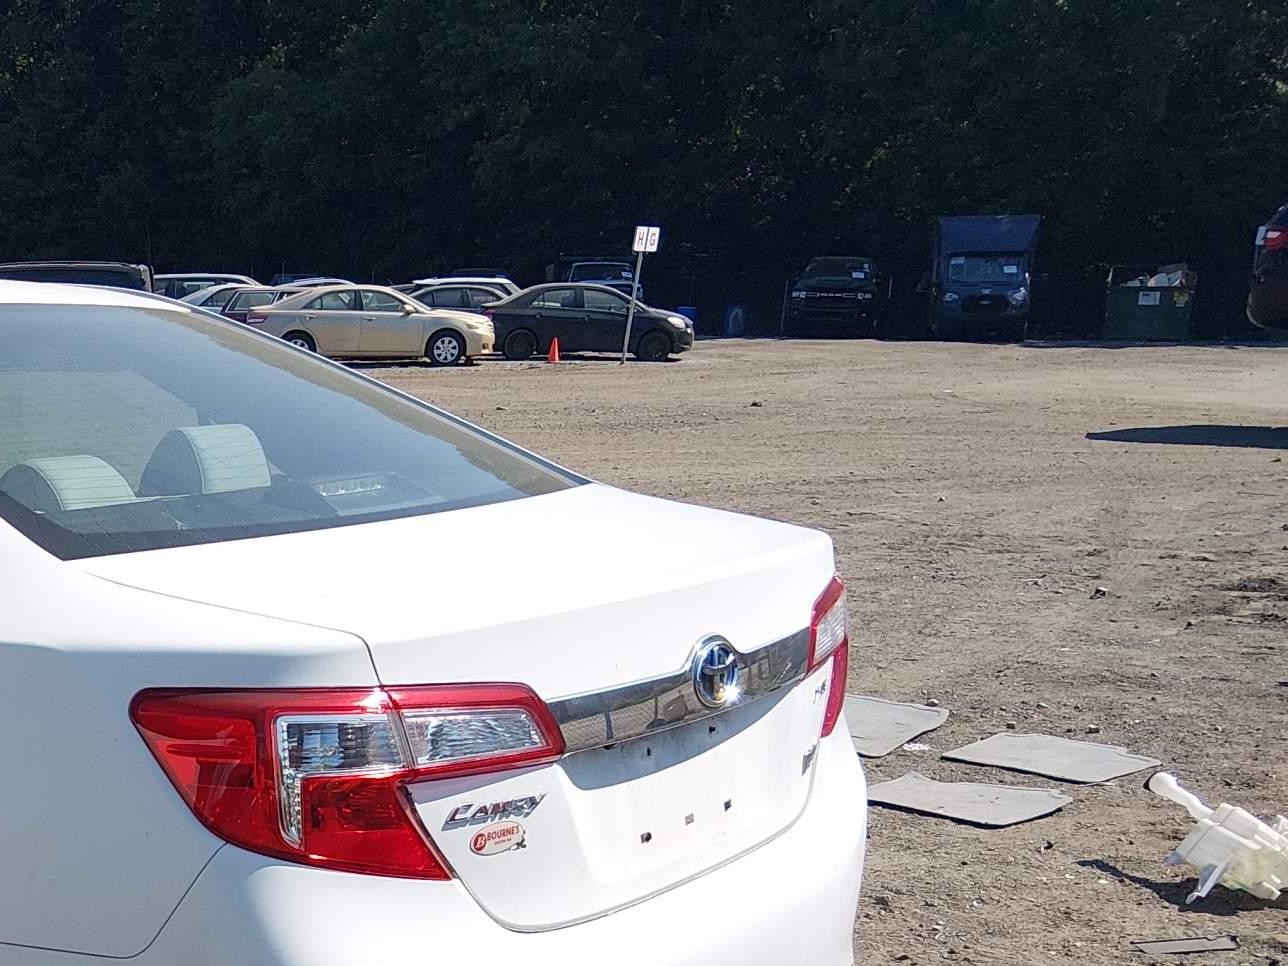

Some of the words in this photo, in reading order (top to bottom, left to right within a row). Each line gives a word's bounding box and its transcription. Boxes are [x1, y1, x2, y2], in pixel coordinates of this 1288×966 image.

[638, 231, 645, 248] H
[649, 232, 657, 246] G
[442, 793, 548, 831] CAMRY
